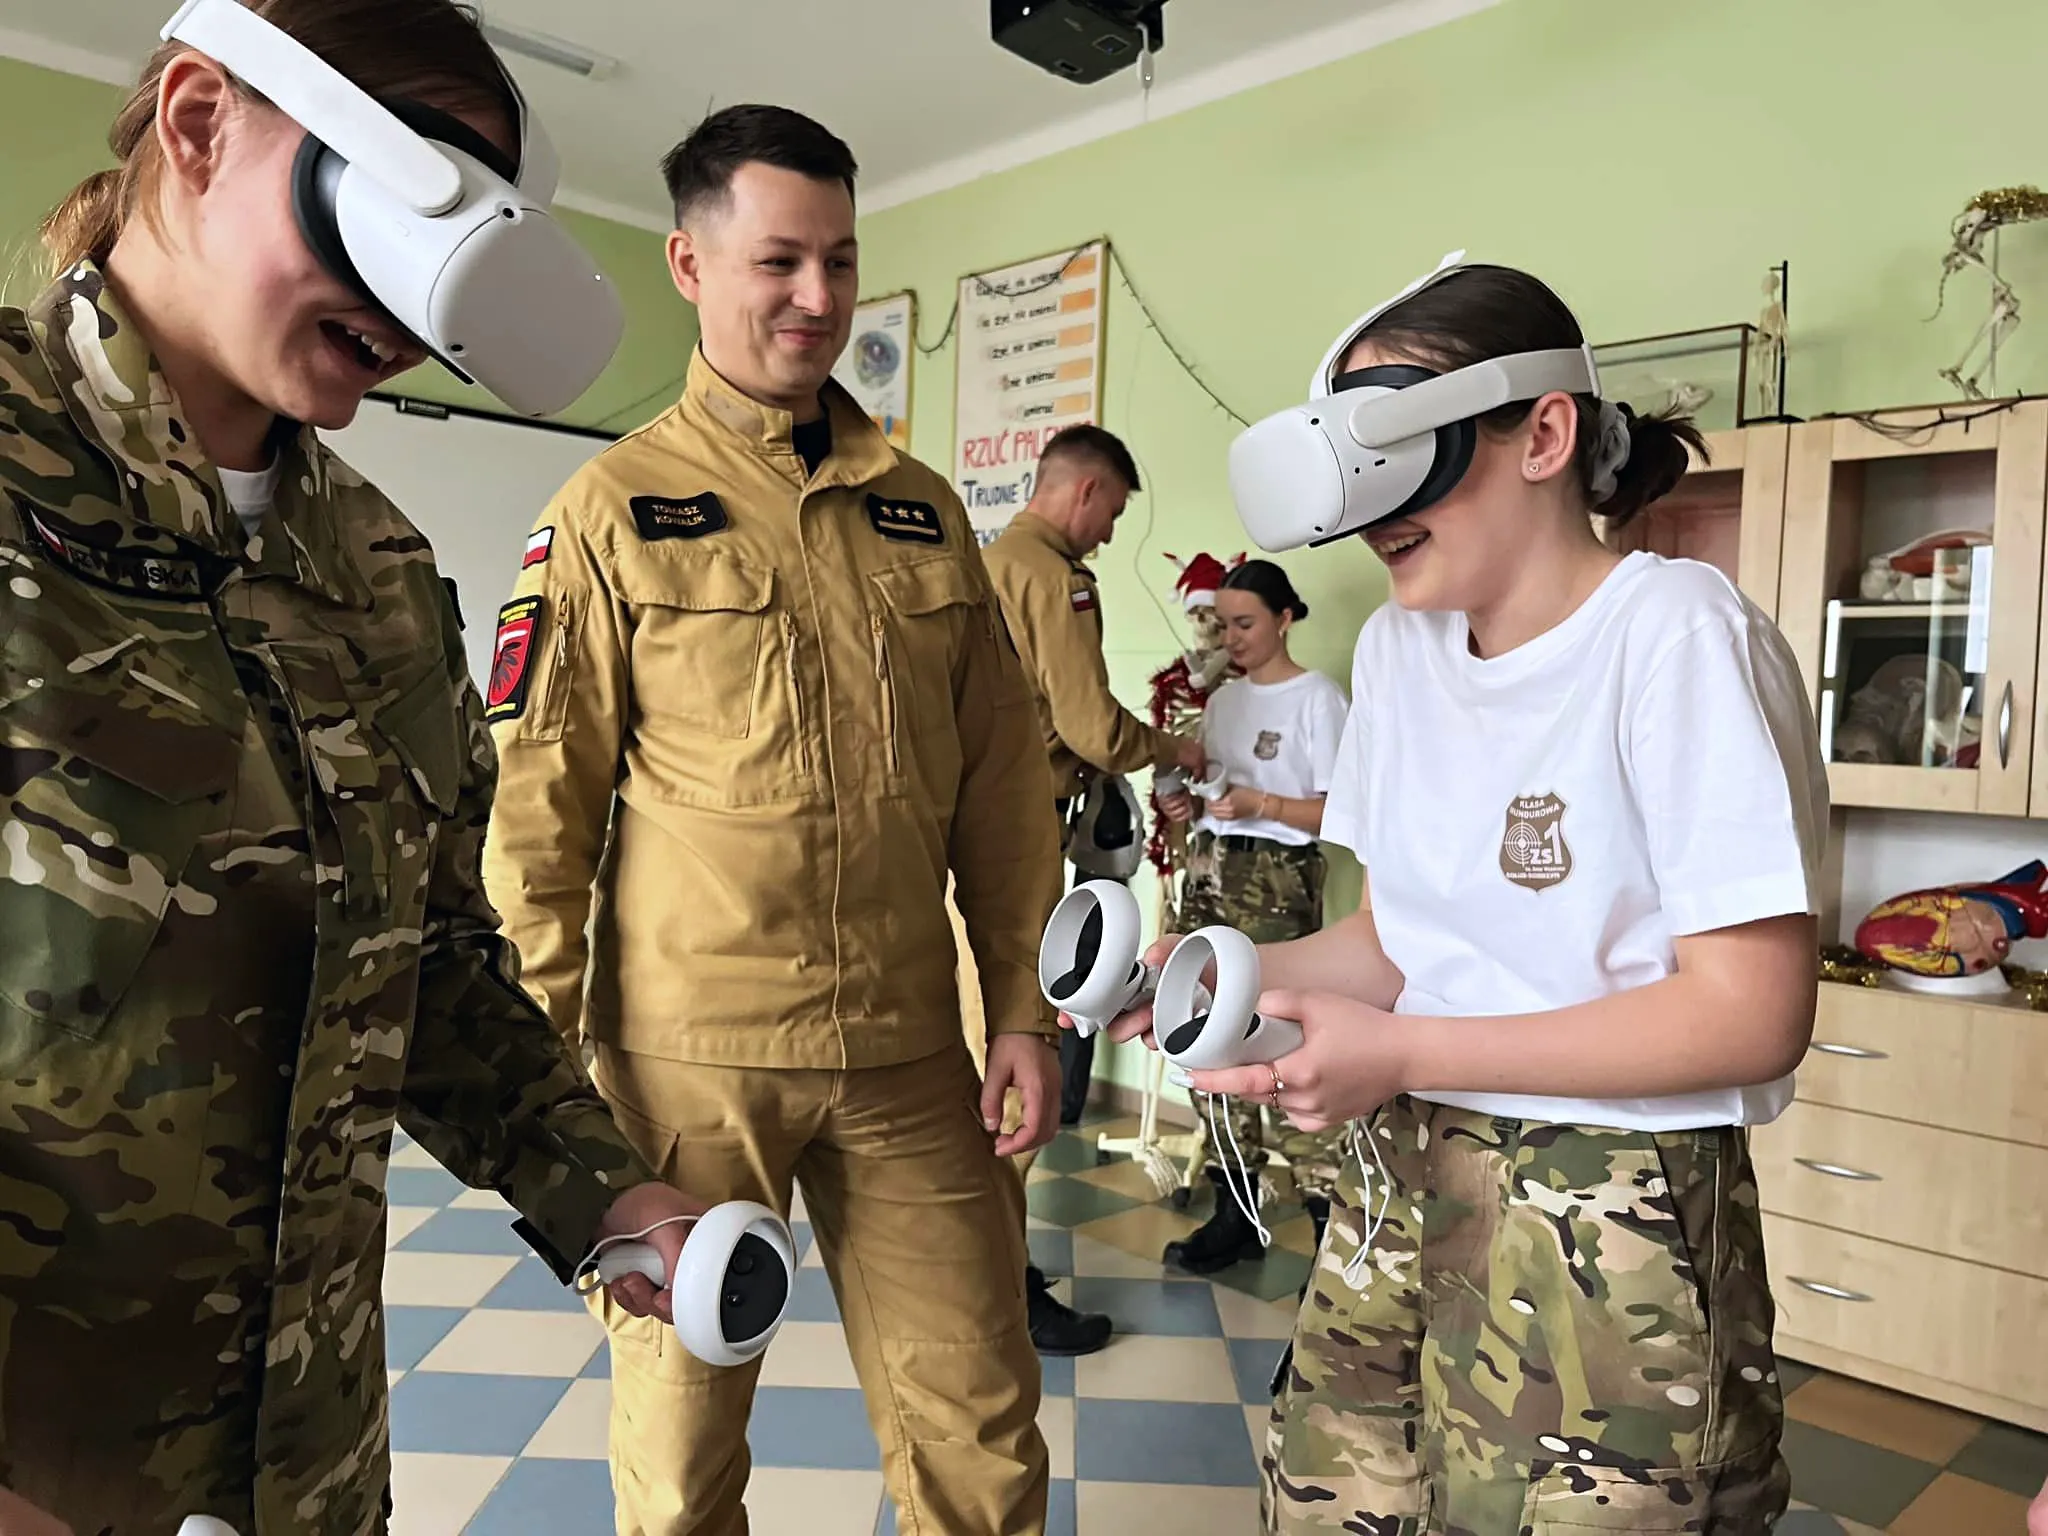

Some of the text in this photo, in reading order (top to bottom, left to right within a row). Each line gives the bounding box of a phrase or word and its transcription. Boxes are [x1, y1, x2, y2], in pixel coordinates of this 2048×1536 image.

[963, 428, 1010, 469] RZUĆ
[1509, 803, 1560, 819] MUNDUROWA
[1519, 799, 1545, 809] KLASA
[1544, 820, 1563, 865] 1
